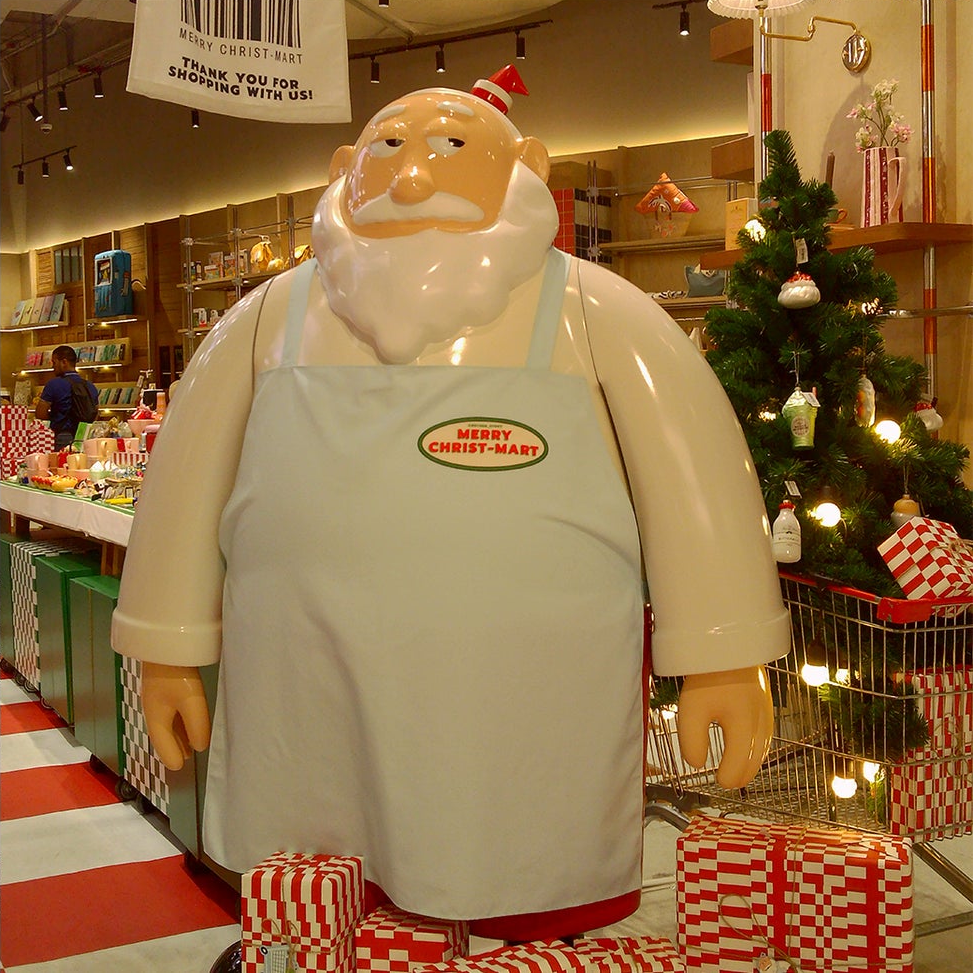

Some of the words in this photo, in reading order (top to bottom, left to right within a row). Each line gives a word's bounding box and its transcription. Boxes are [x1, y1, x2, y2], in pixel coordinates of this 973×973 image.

[178, 27, 214, 52] MERRY
[219, 43, 304, 65] CHRIST-MART
[168, 65, 241, 96] SHOPPING
[247, 86, 283, 101] WITH
[289, 89, 314, 101] US!
[182, 56, 228, 82] THANK
[235, 72, 268, 87] YOU
[273, 78, 300, 90] FOR
[428, 441, 539, 456] CHRIST-MART
[457, 429, 512, 441] MERRY
